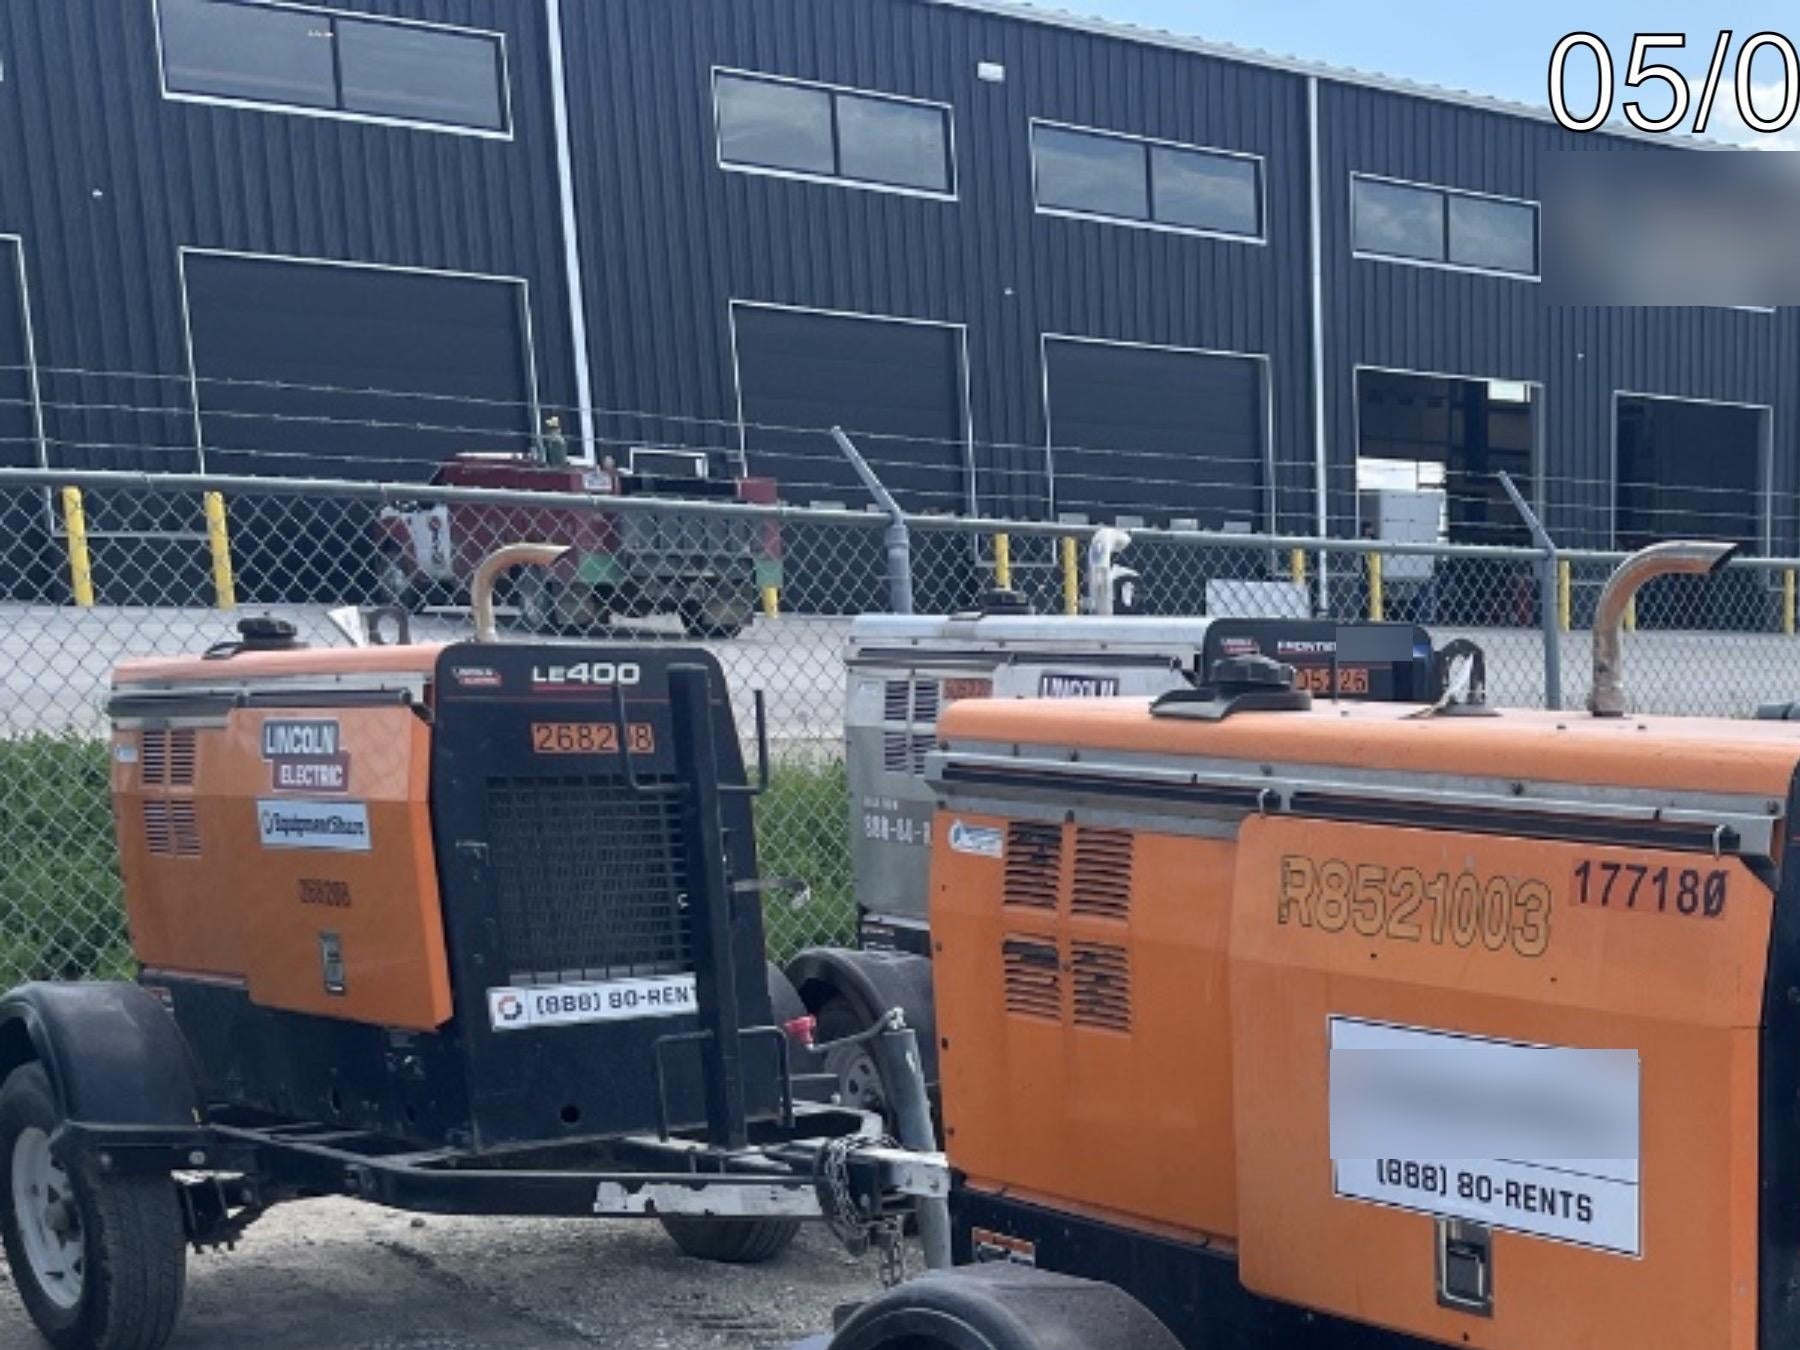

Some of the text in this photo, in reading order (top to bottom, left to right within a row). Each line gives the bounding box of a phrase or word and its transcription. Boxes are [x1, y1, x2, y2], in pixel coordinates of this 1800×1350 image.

[1276, 639, 1337, 654] FRONTIE
[532, 661, 641, 685] LE400
[265, 724, 336, 755] LINCOLN
[535, 724, 653, 751] 26828
[279, 763, 344, 788] ELECTRIC
[1573, 859, 1731, 918] 177180
[1278, 854, 1553, 958] R8521003
[607, 984, 697, 1009] 80-REN
[1376, 1158, 1594, 1224] (888) 80-RENTS
